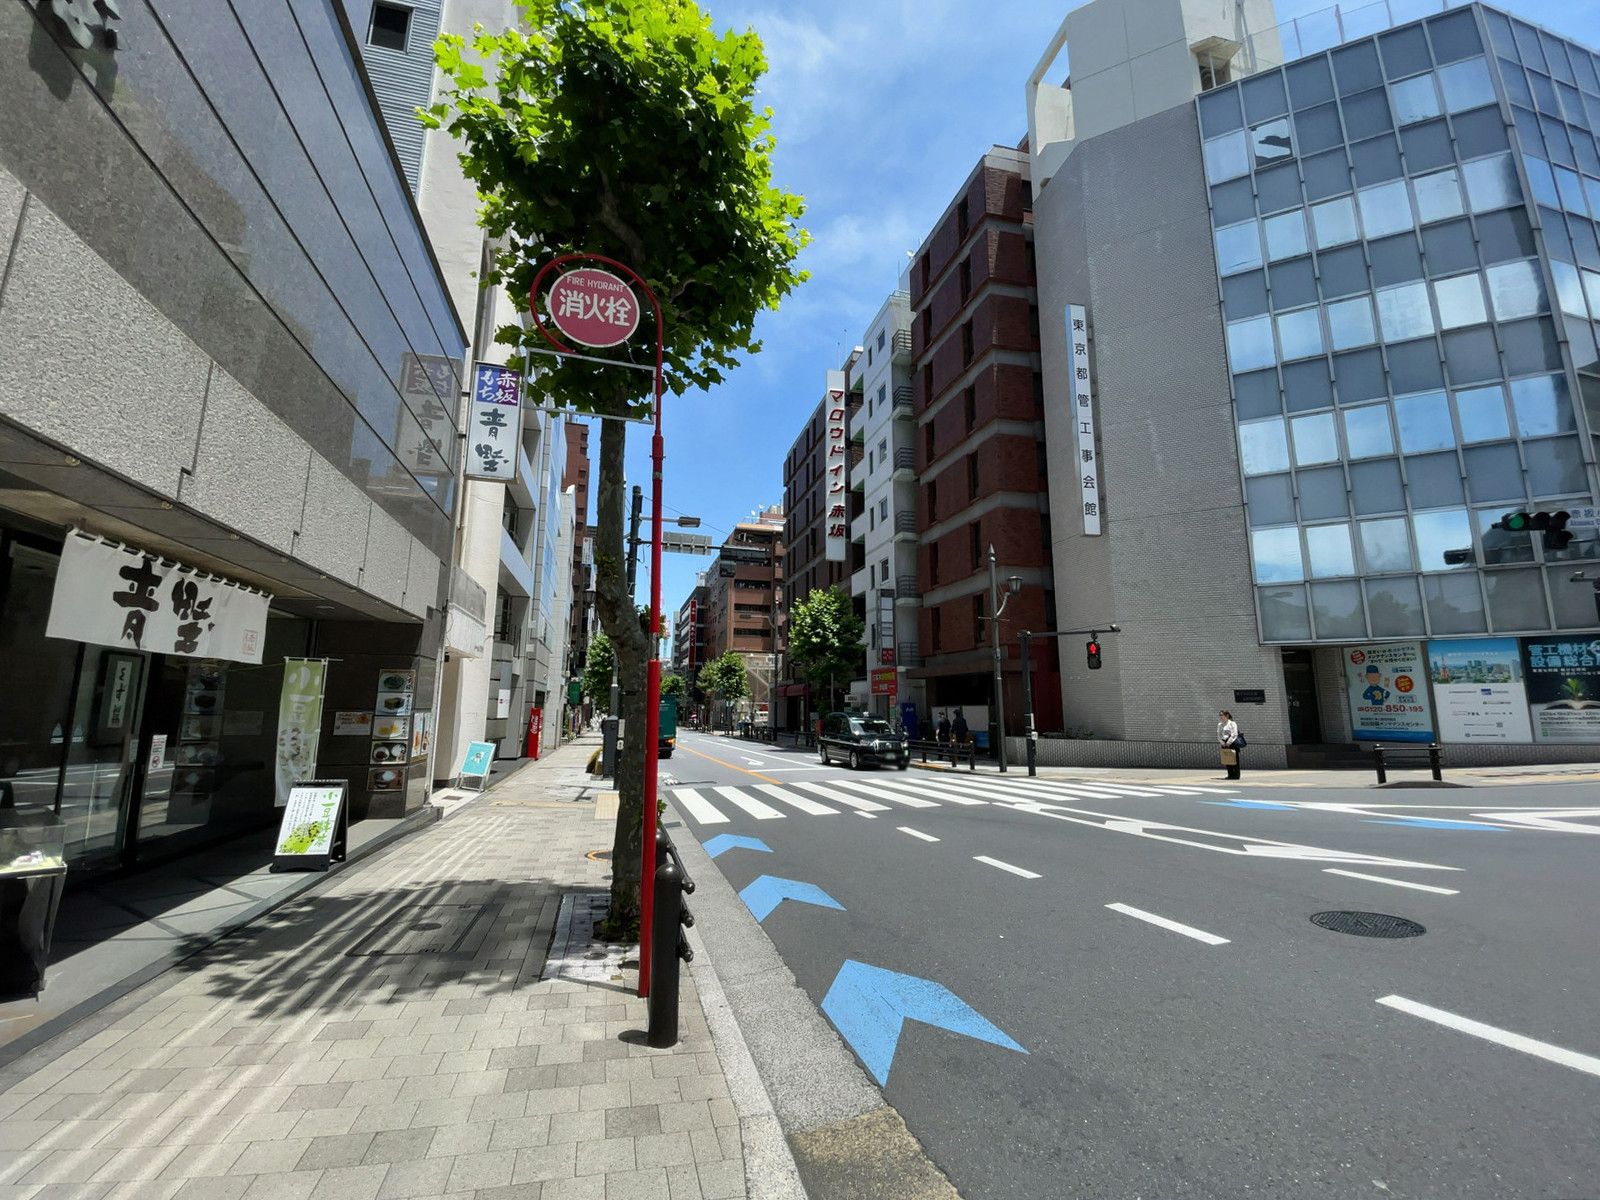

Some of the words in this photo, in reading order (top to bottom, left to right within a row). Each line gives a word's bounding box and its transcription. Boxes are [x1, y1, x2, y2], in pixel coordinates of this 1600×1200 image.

[566, 275, 585, 287] FIRE
[587, 279, 625, 293] HYDRANT
[558, 288, 632, 327] 消火栓
[478, 369, 496, 401] もち
[494, 371, 517, 403] 赤坂
[1072, 318, 1098, 517] 東京都管工事会館
[475, 408, 509, 472] 青野
[113, 556, 215, 653] 青野
